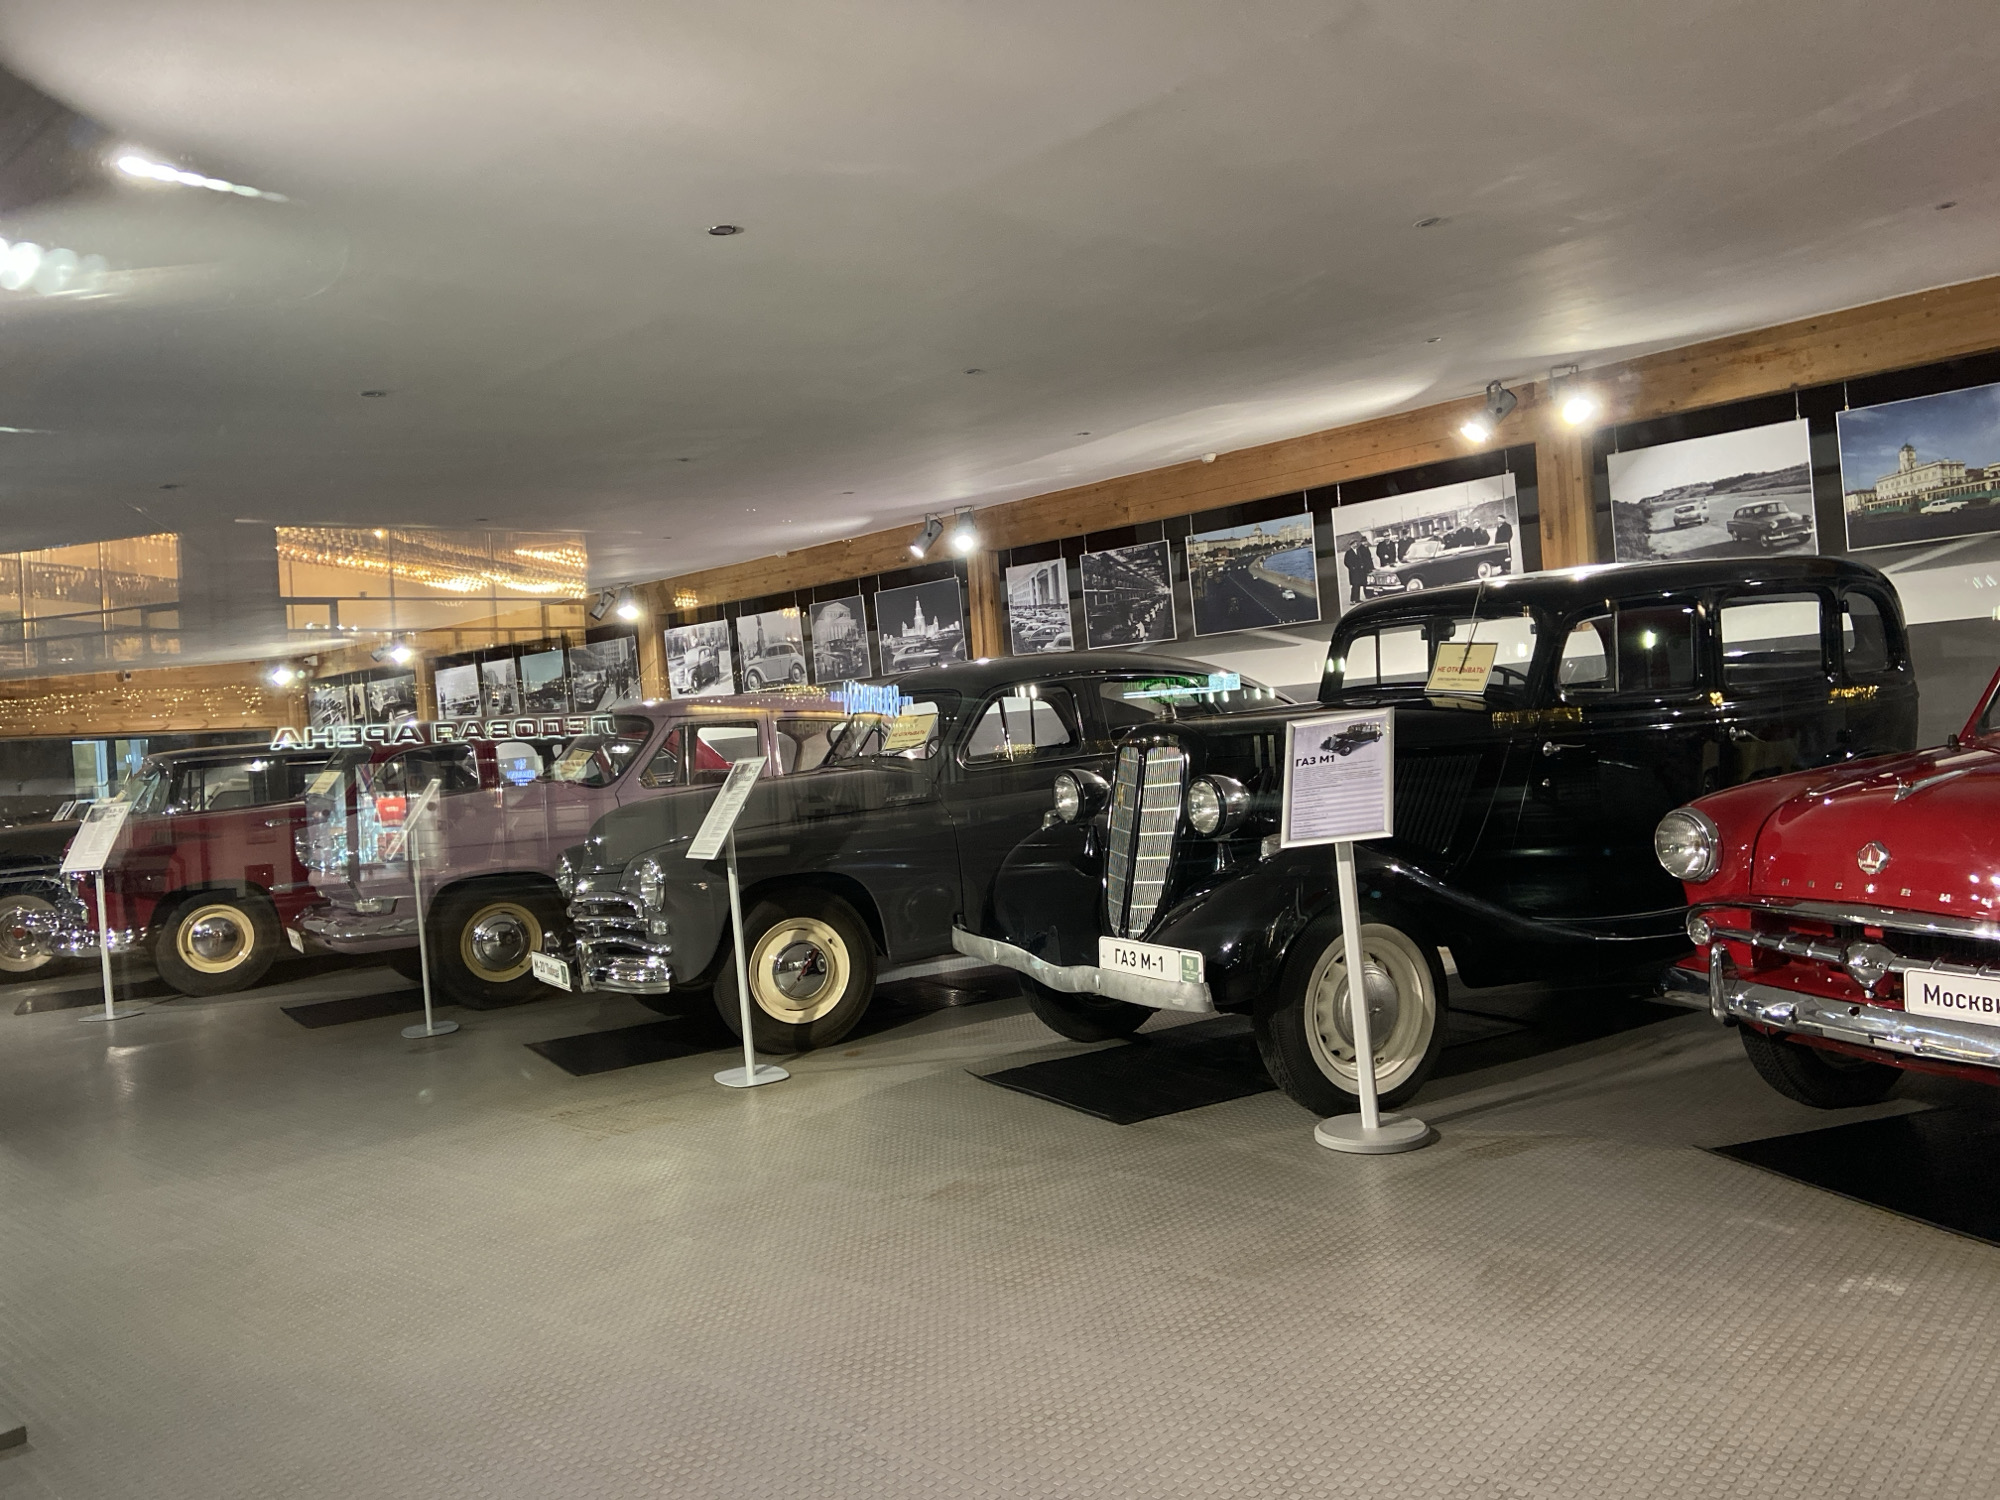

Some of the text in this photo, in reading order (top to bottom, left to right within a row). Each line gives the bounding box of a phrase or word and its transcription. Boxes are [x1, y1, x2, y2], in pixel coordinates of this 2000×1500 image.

[1295, 755, 1335, 767] ГАЗ М1
[1115, 948, 1164, 972] ГАЗ М-1
